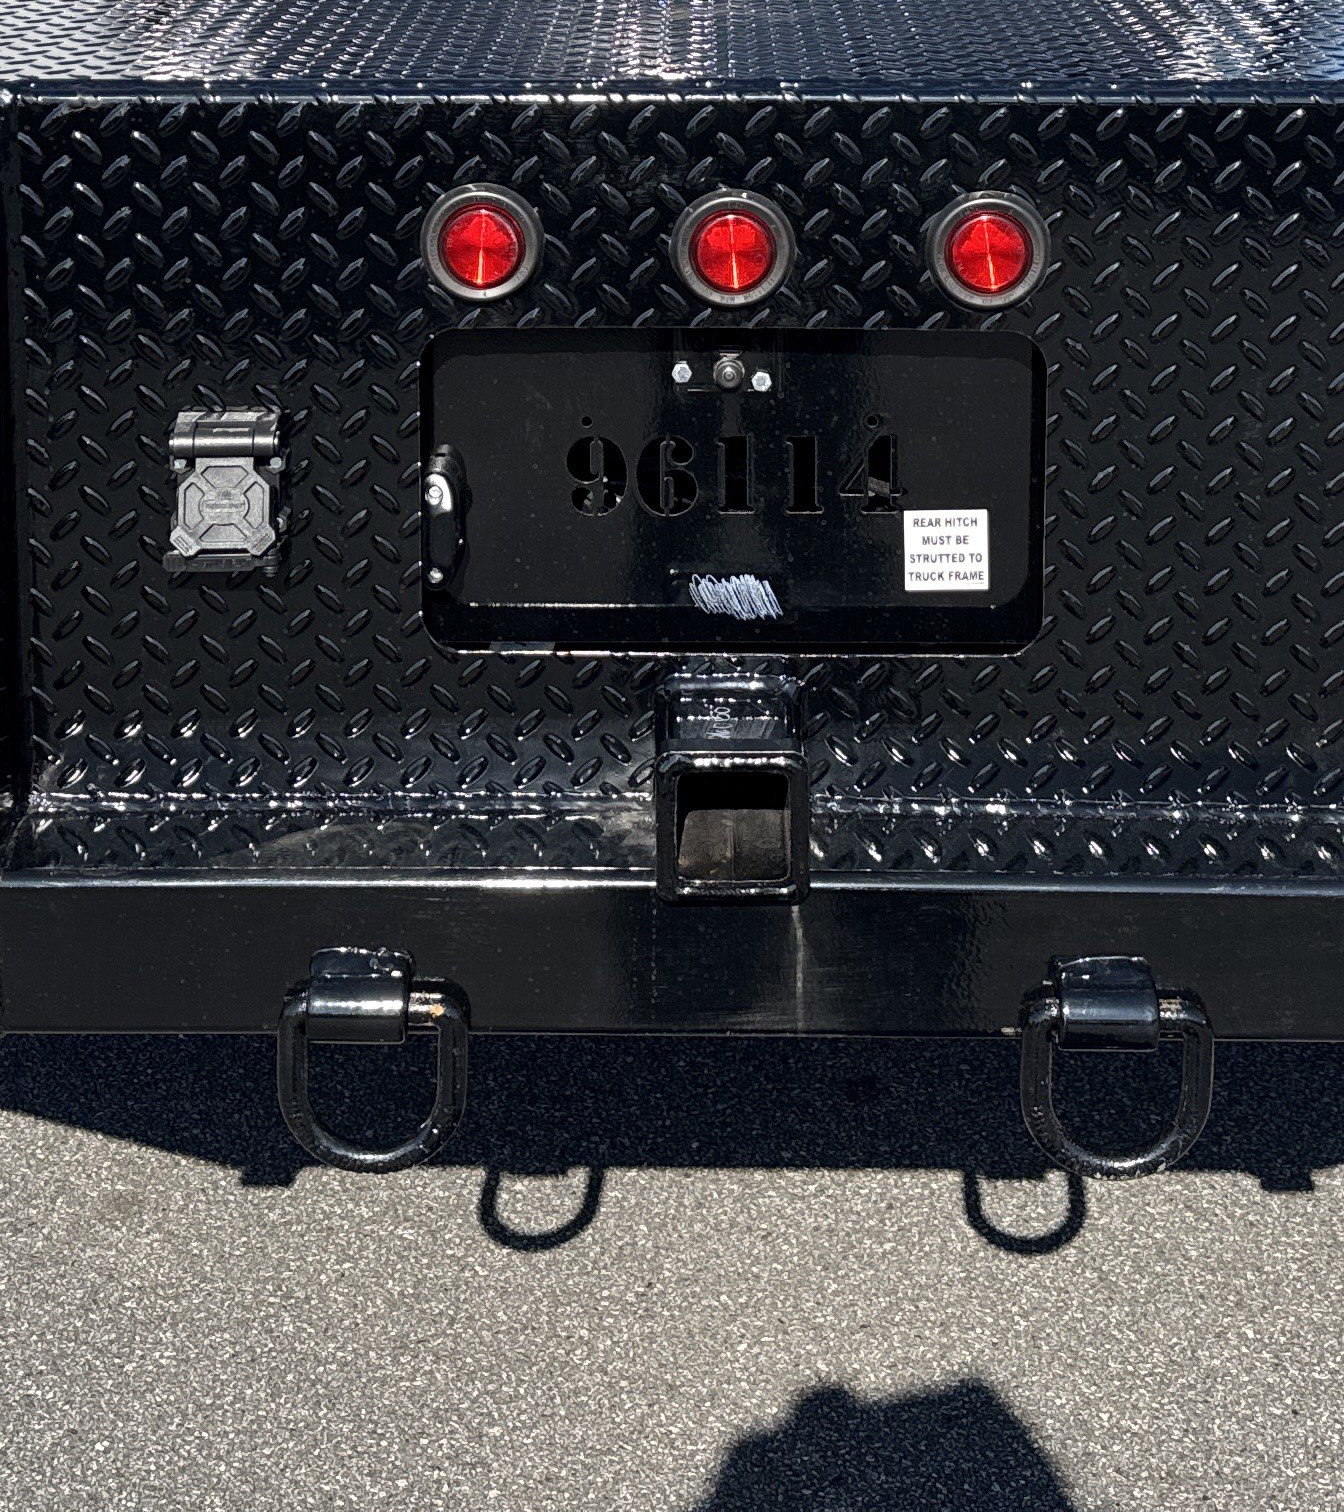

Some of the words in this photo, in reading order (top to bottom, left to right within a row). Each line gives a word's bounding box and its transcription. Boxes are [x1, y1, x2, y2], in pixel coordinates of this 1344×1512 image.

[566, 435, 906, 517] 96114
[912, 517, 942, 528] REAR
[944, 516, 978, 528] HITCH
[921, 535, 952, 546] MUST
[955, 534, 970, 545] BE
[909, 552, 966, 564] STRUTTED
[968, 552, 983, 563] TO
[908, 571, 945, 582] TRUCK
[948, 570, 985, 581] FRAME
